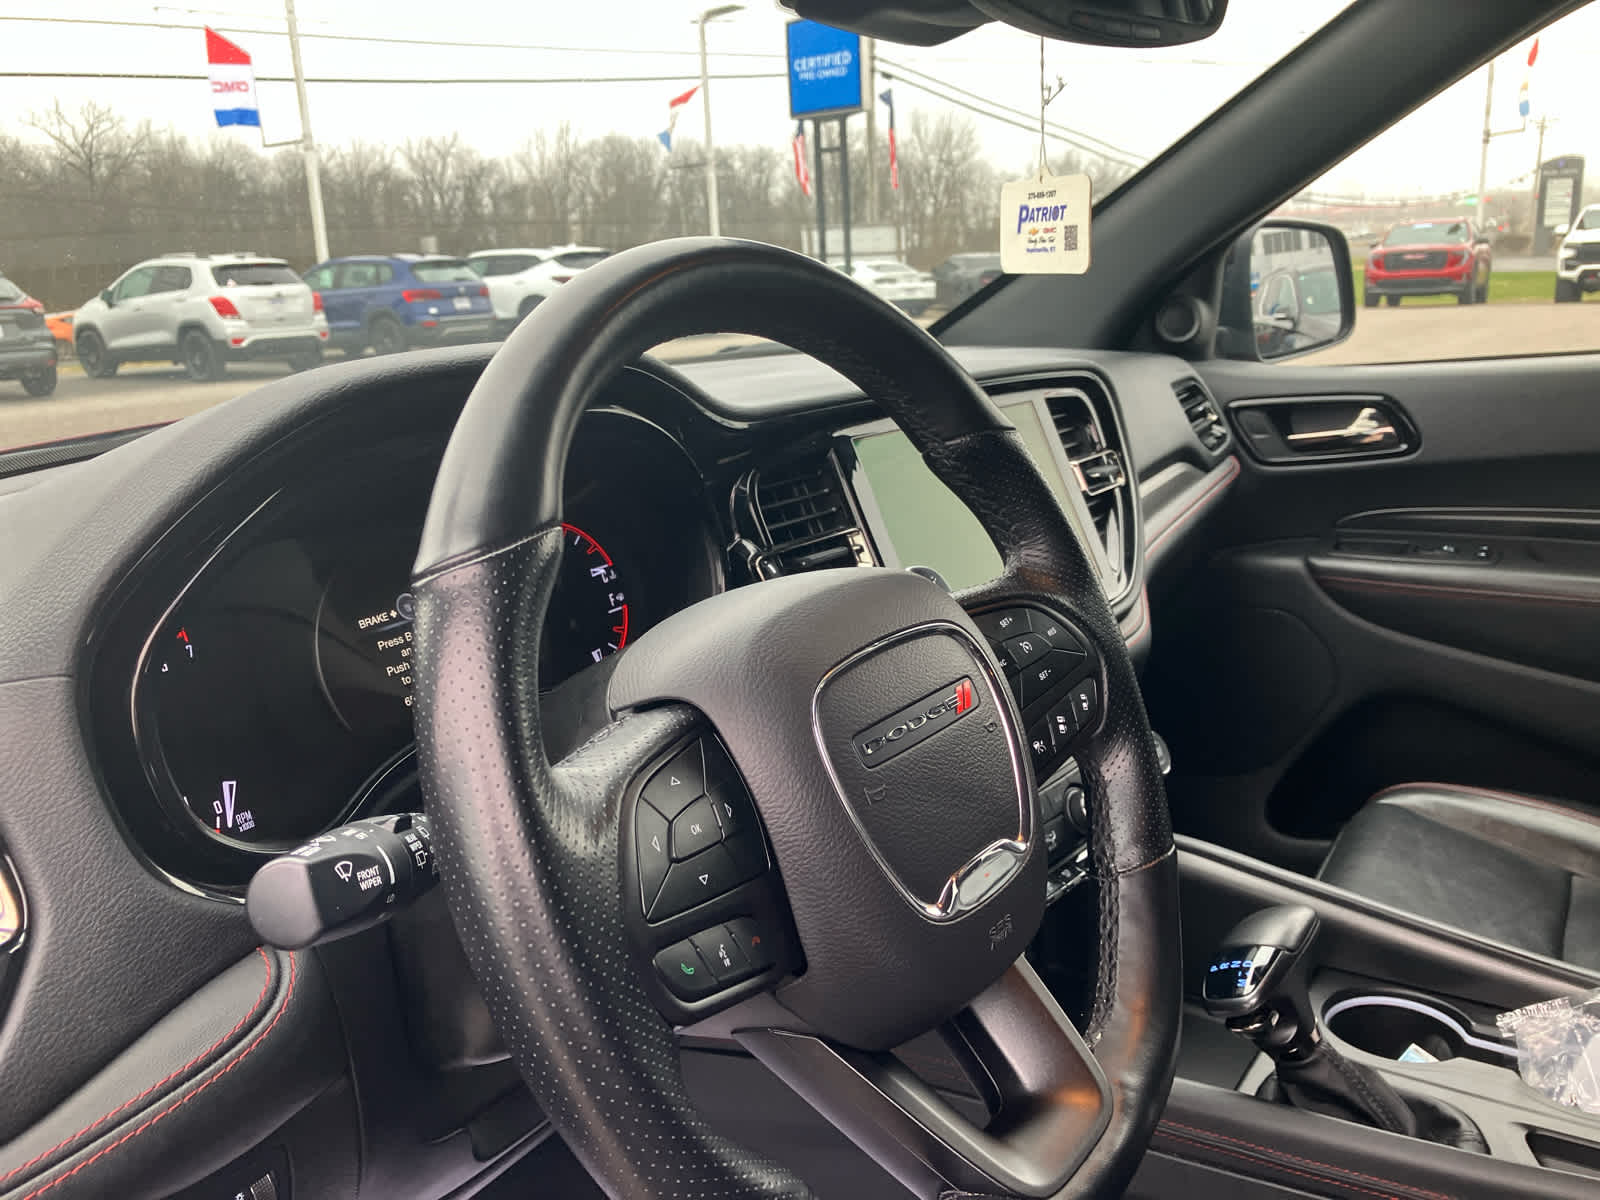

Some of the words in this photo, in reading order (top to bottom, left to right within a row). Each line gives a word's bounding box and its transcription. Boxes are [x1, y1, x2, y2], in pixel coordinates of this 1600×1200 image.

[794, 50, 852, 73] CERTIFIED
[1016, 204, 1068, 235] PATRIOT
[358, 612, 389, 630] BRAKE
[377, 636, 404, 652] Press
[401, 646, 412, 657] an
[386, 661, 411, 677] Push
[861, 693, 961, 755] DODGE
[236, 809, 252, 826] RPM
[690, 823, 703, 835] OK
[356, 864, 381, 882] FRONT
[359, 876, 382, 892] WIPER
